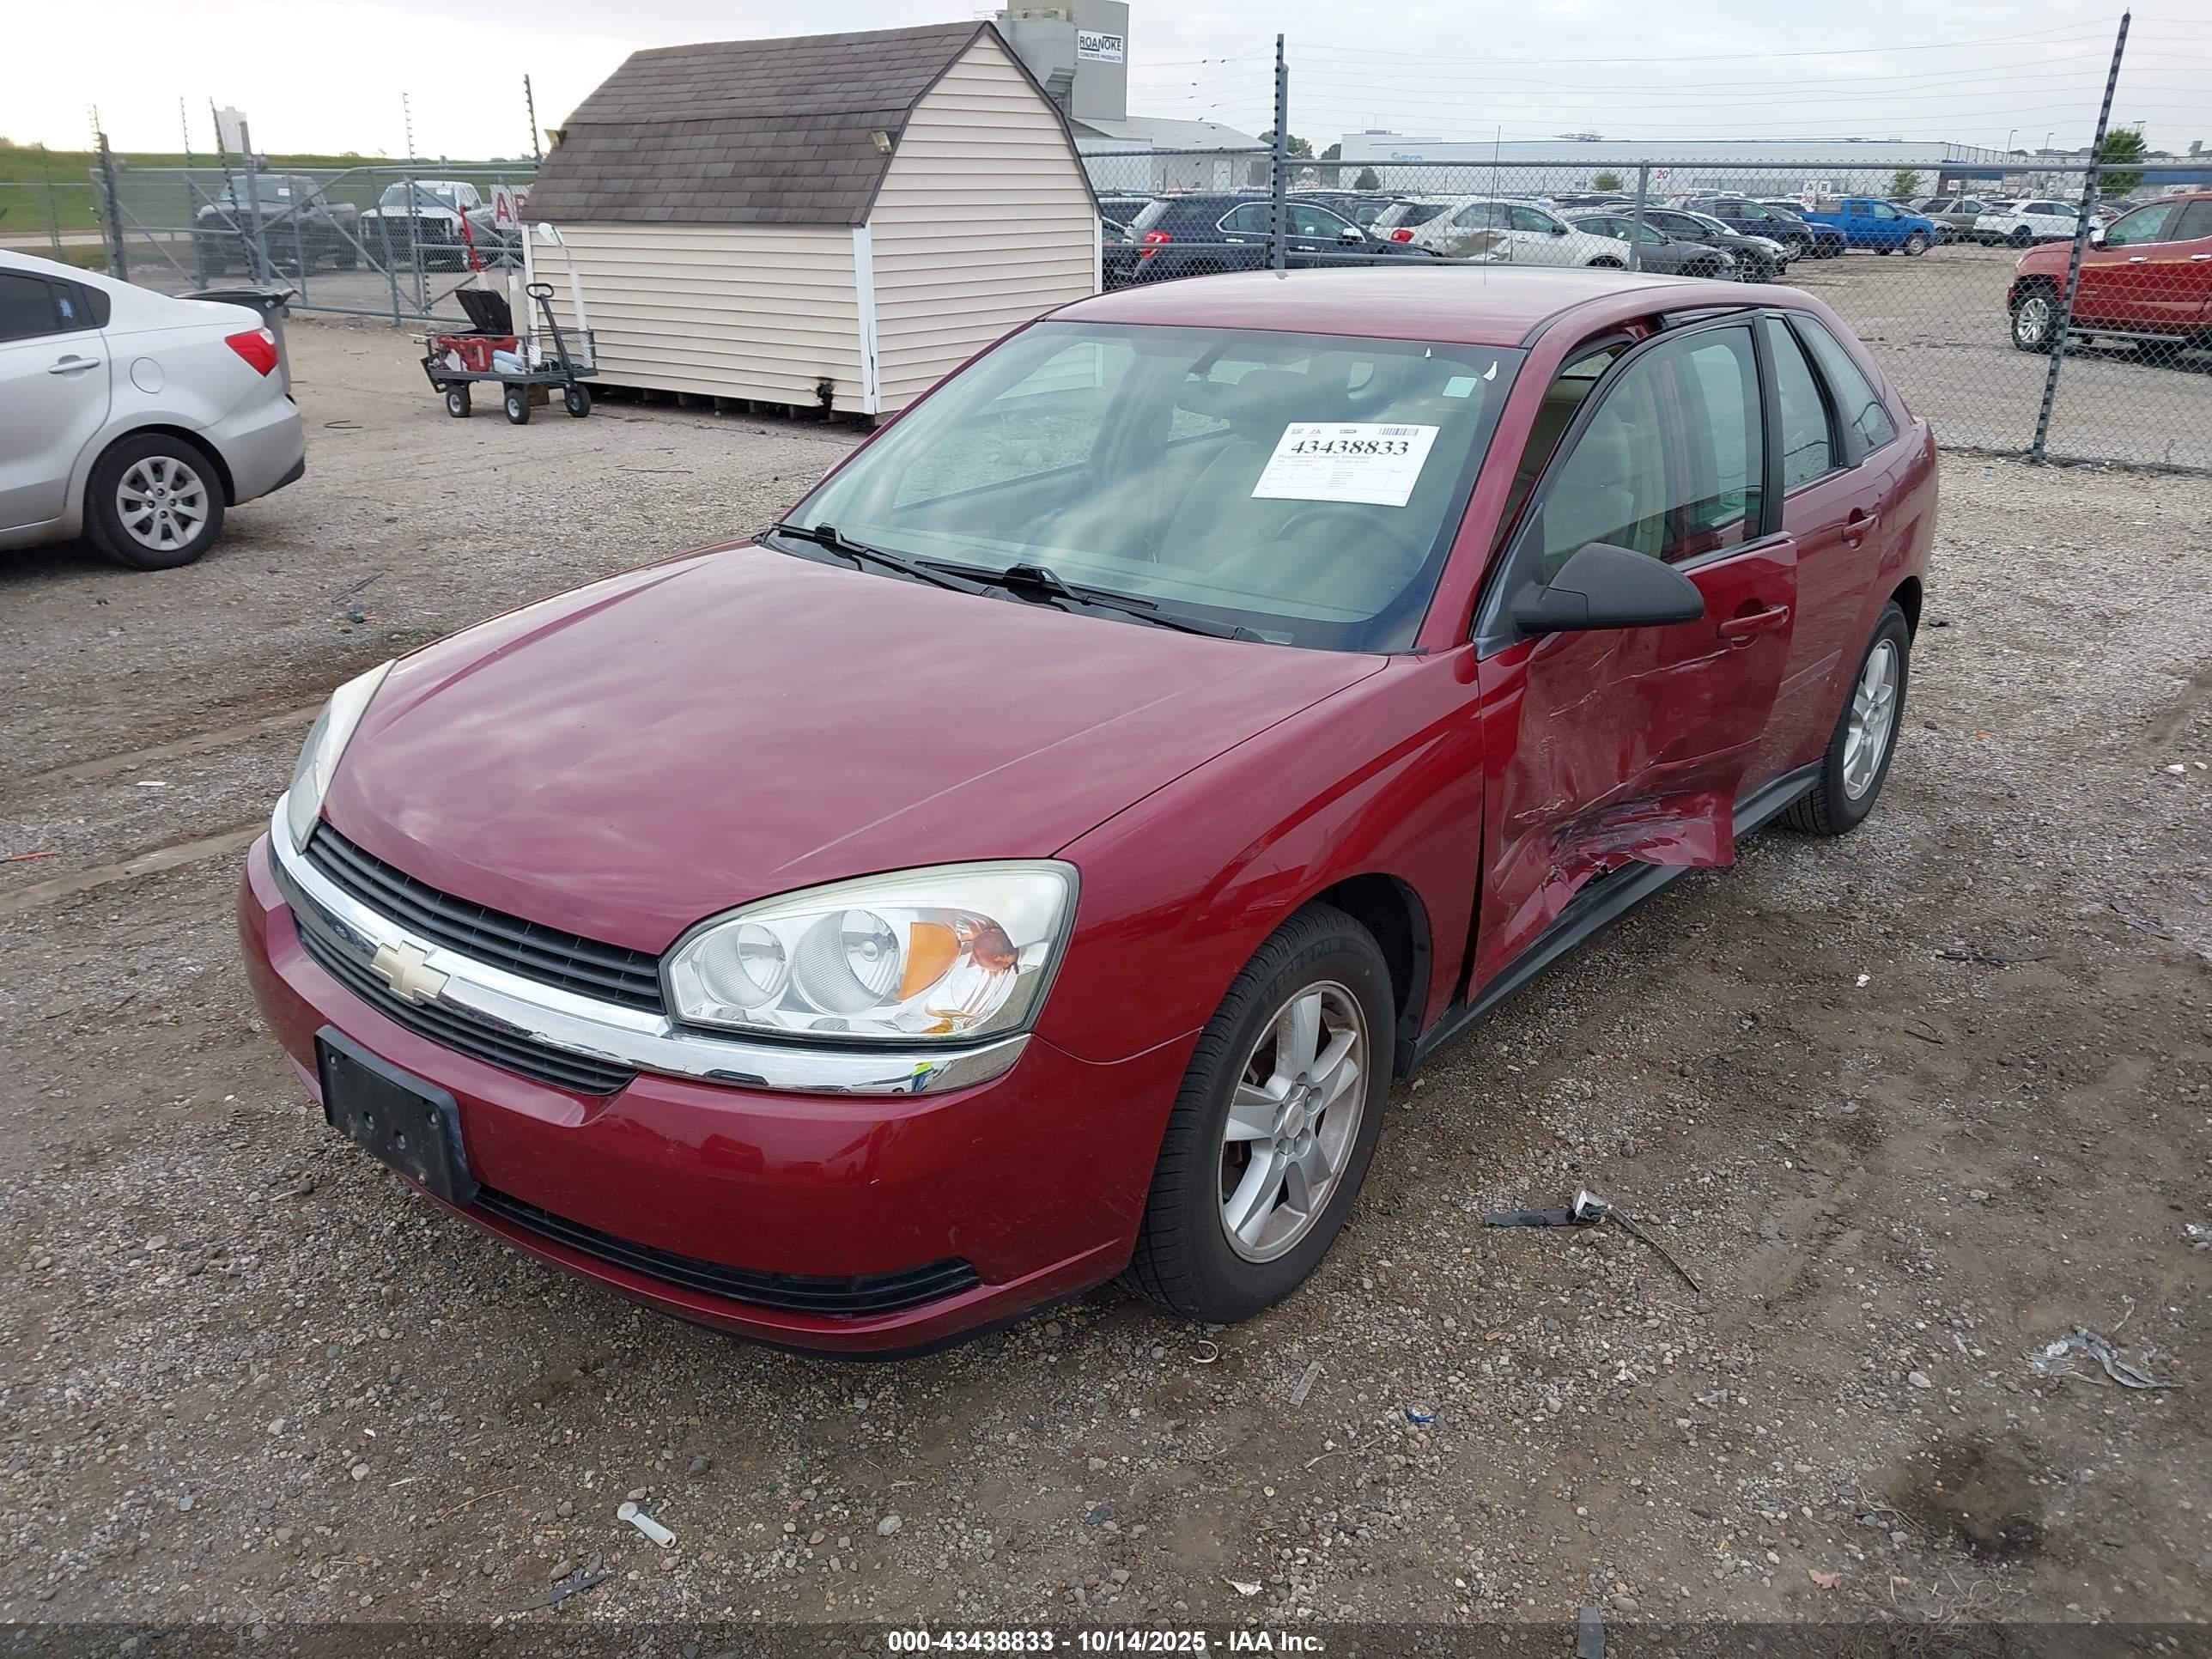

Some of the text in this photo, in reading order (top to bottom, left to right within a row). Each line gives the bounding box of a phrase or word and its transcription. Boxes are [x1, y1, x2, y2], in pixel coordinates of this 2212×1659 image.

[1079, 35, 1121, 52] ROANOKE
[1656, 169, 1668, 179] 20
[1291, 440, 1409, 456] 43438833
